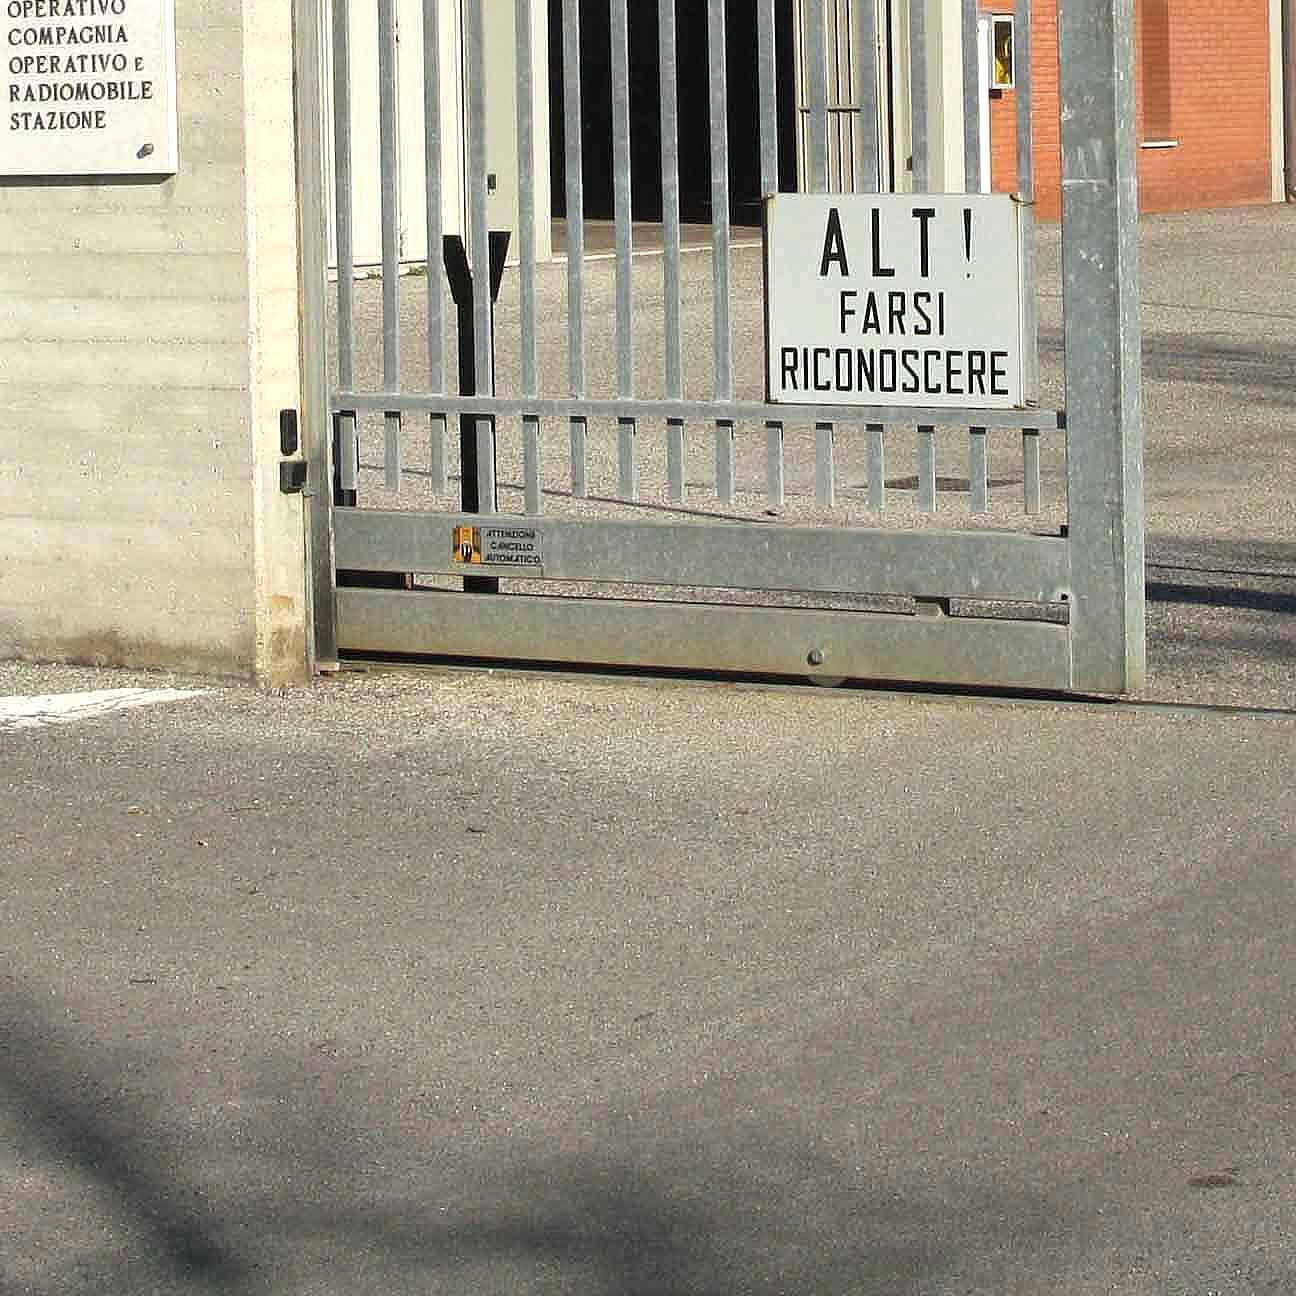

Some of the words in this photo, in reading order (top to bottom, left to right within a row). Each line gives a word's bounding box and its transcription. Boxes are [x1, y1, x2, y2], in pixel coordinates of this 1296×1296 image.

[7, 24, 128, 46] COMPAGNIA
[8, 53, 127, 75] OPERATIVO
[8, 80, 153, 103] RADIOMOBILE
[9, 110, 106, 131] STAZIONE
[840, 291, 944, 336] FARSI
[781, 347, 1009, 395] RICONOSCERE
